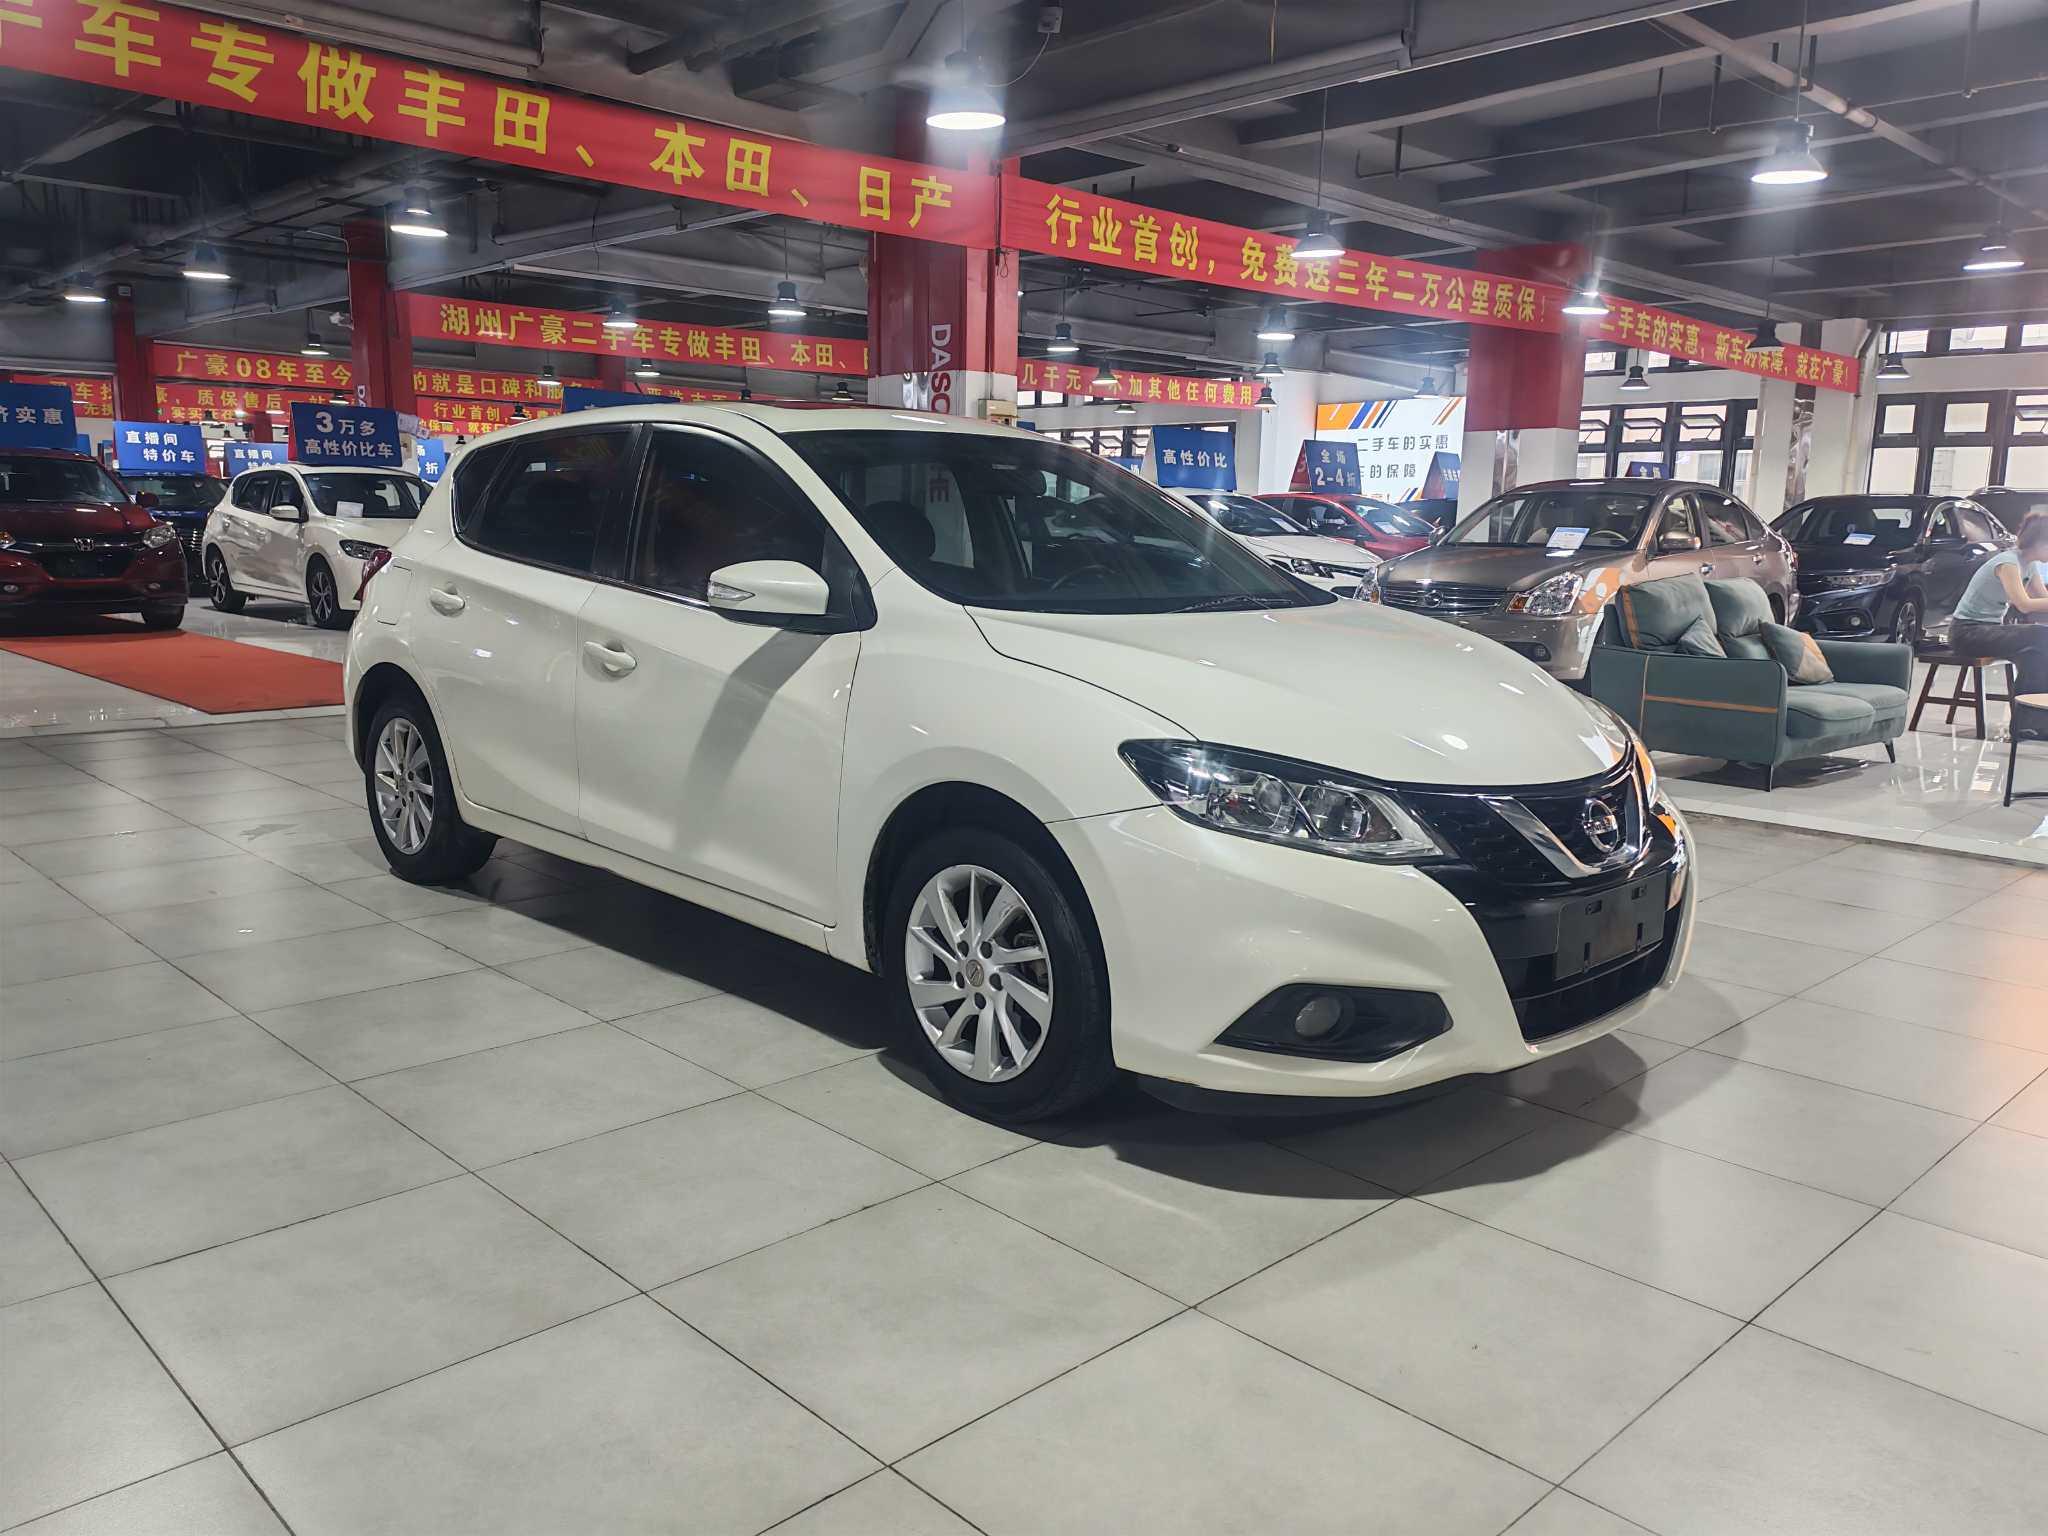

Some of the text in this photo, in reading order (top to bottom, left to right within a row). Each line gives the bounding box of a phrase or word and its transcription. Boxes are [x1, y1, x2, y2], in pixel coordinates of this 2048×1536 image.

[315, 411, 376, 437] 3万多
[126, 430, 178, 446] 直播间
[304, 438, 394, 458] 高性价比车
[143, 448, 196, 464] 特价车
[1163, 448, 1228, 468] 高性价比
